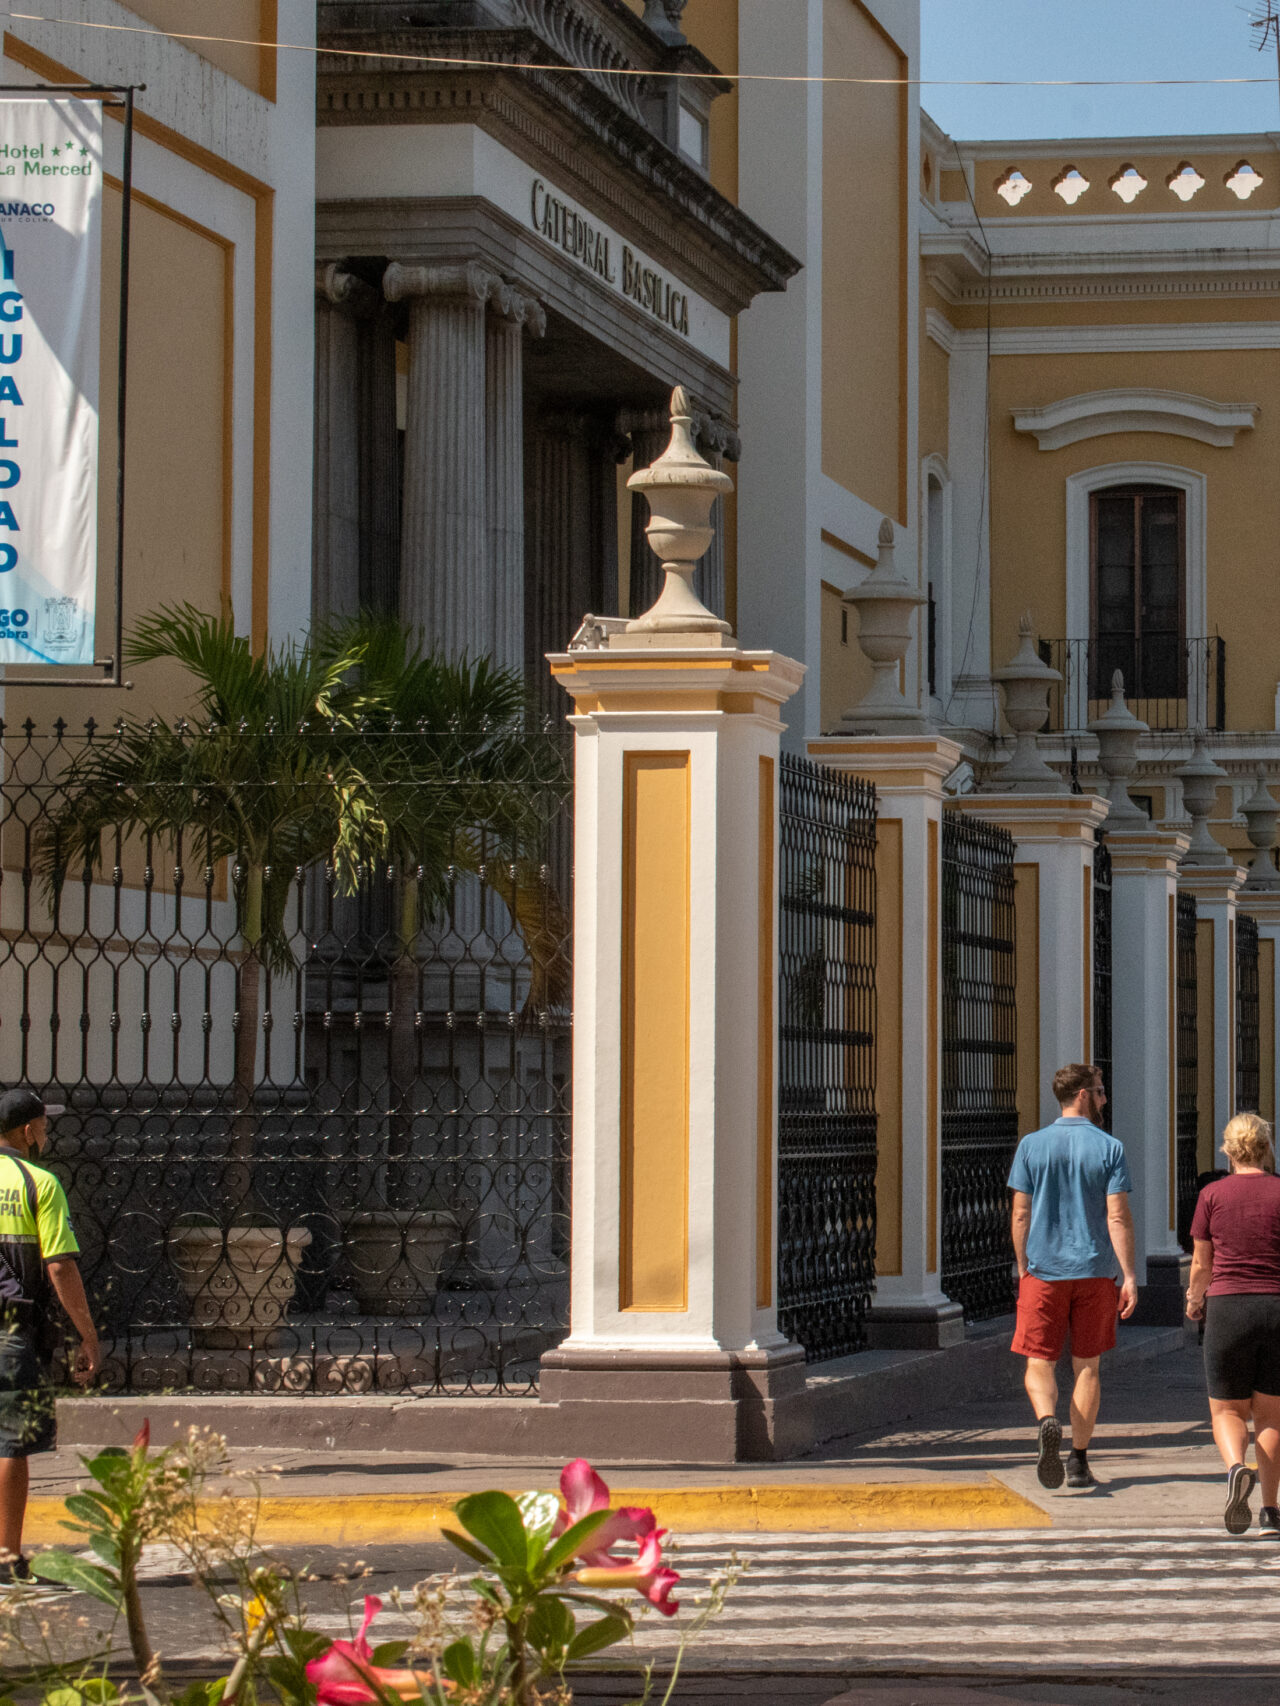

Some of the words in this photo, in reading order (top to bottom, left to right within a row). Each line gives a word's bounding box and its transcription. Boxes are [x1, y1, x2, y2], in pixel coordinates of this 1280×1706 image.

[24, 161, 92, 175] Merced
[531, 179, 615, 283] CATEDRAL
[622, 245, 689, 336] BASILICA
